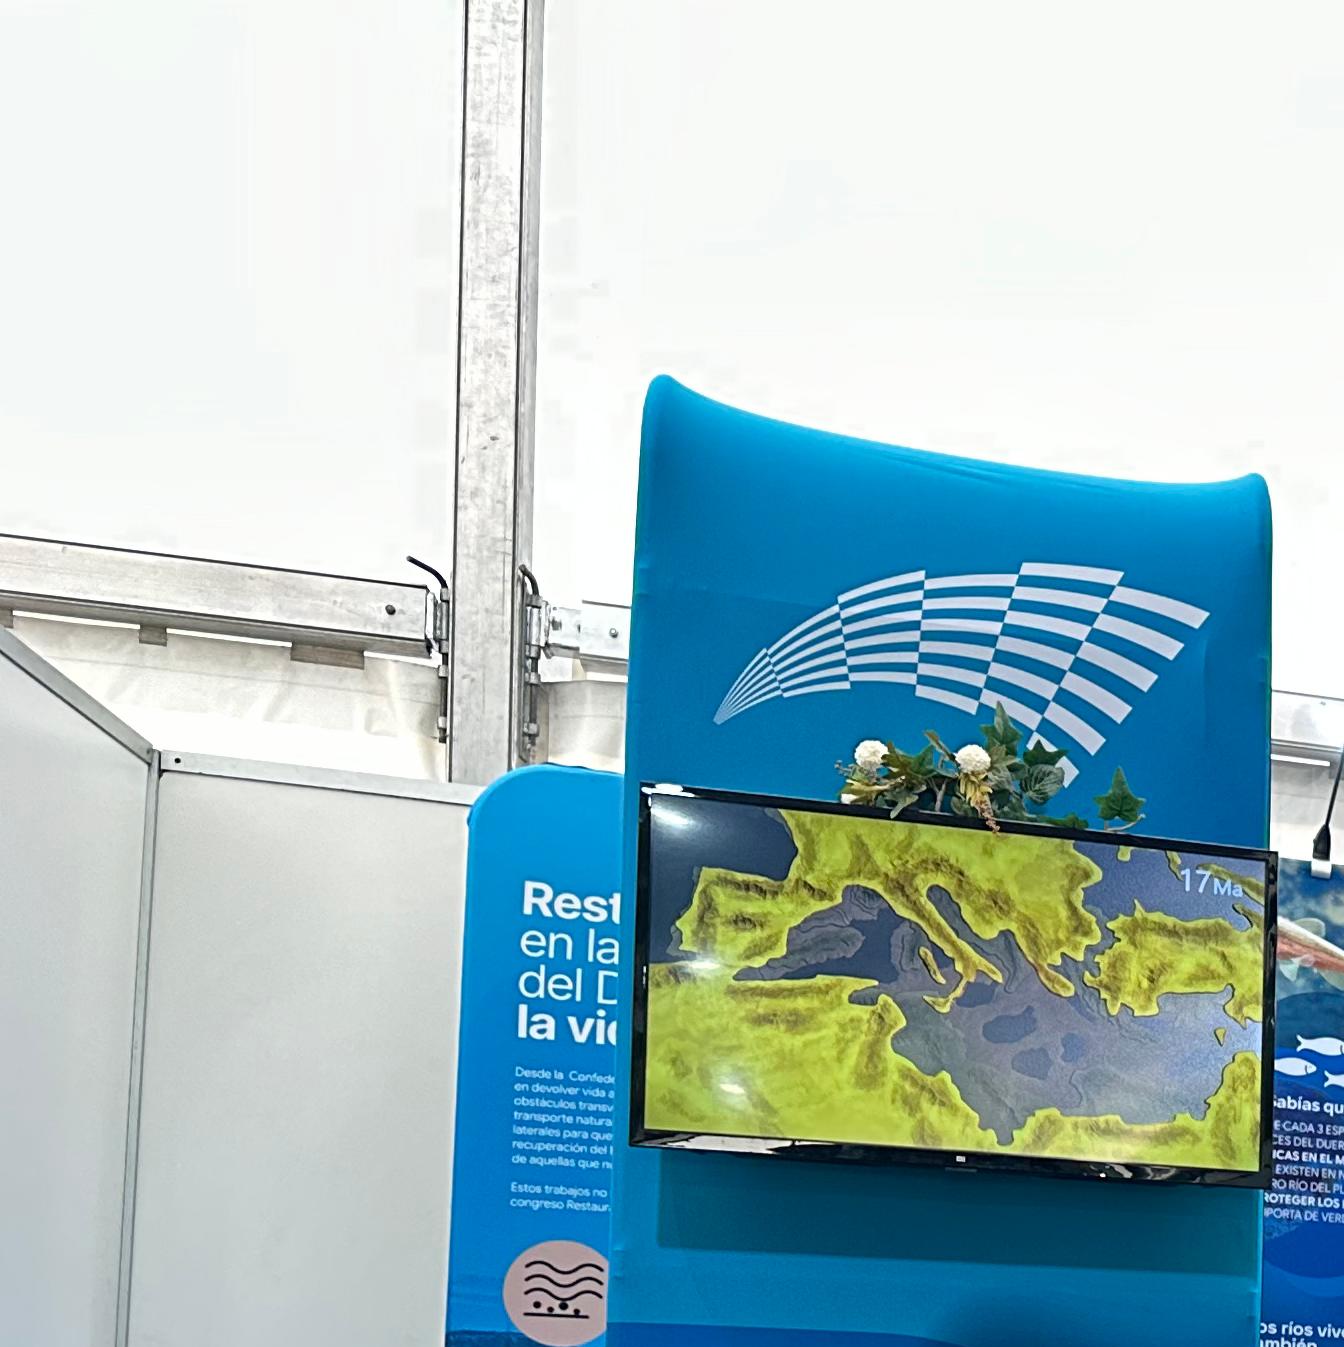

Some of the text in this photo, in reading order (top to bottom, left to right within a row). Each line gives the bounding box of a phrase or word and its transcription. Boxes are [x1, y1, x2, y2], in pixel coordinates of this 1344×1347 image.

[521, 928, 572, 960] en
[519, 964, 582, 1002] del
[518, 1004, 555, 1040] la
[1276, 1165, 1319, 1177] EXISTEN
[1322, 1168, 1336, 1179] EN
